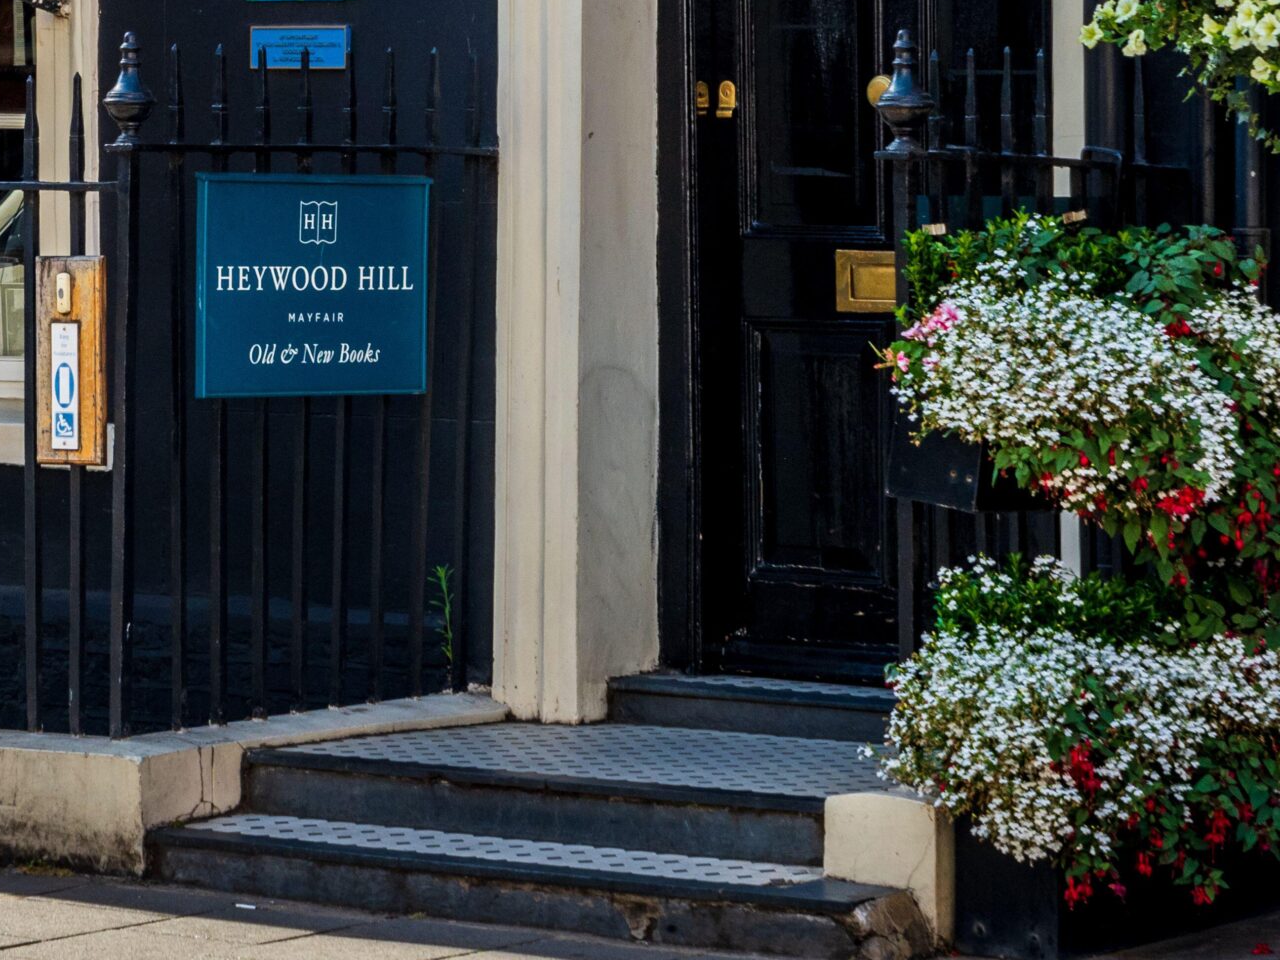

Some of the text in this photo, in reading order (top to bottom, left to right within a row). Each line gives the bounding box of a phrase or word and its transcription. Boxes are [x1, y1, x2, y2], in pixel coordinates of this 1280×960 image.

[216, 266, 414, 291] HEYWOOD HILL
[288, 312, 345, 323] MAYFAIR
[249, 342, 381, 364] Old & New Books
